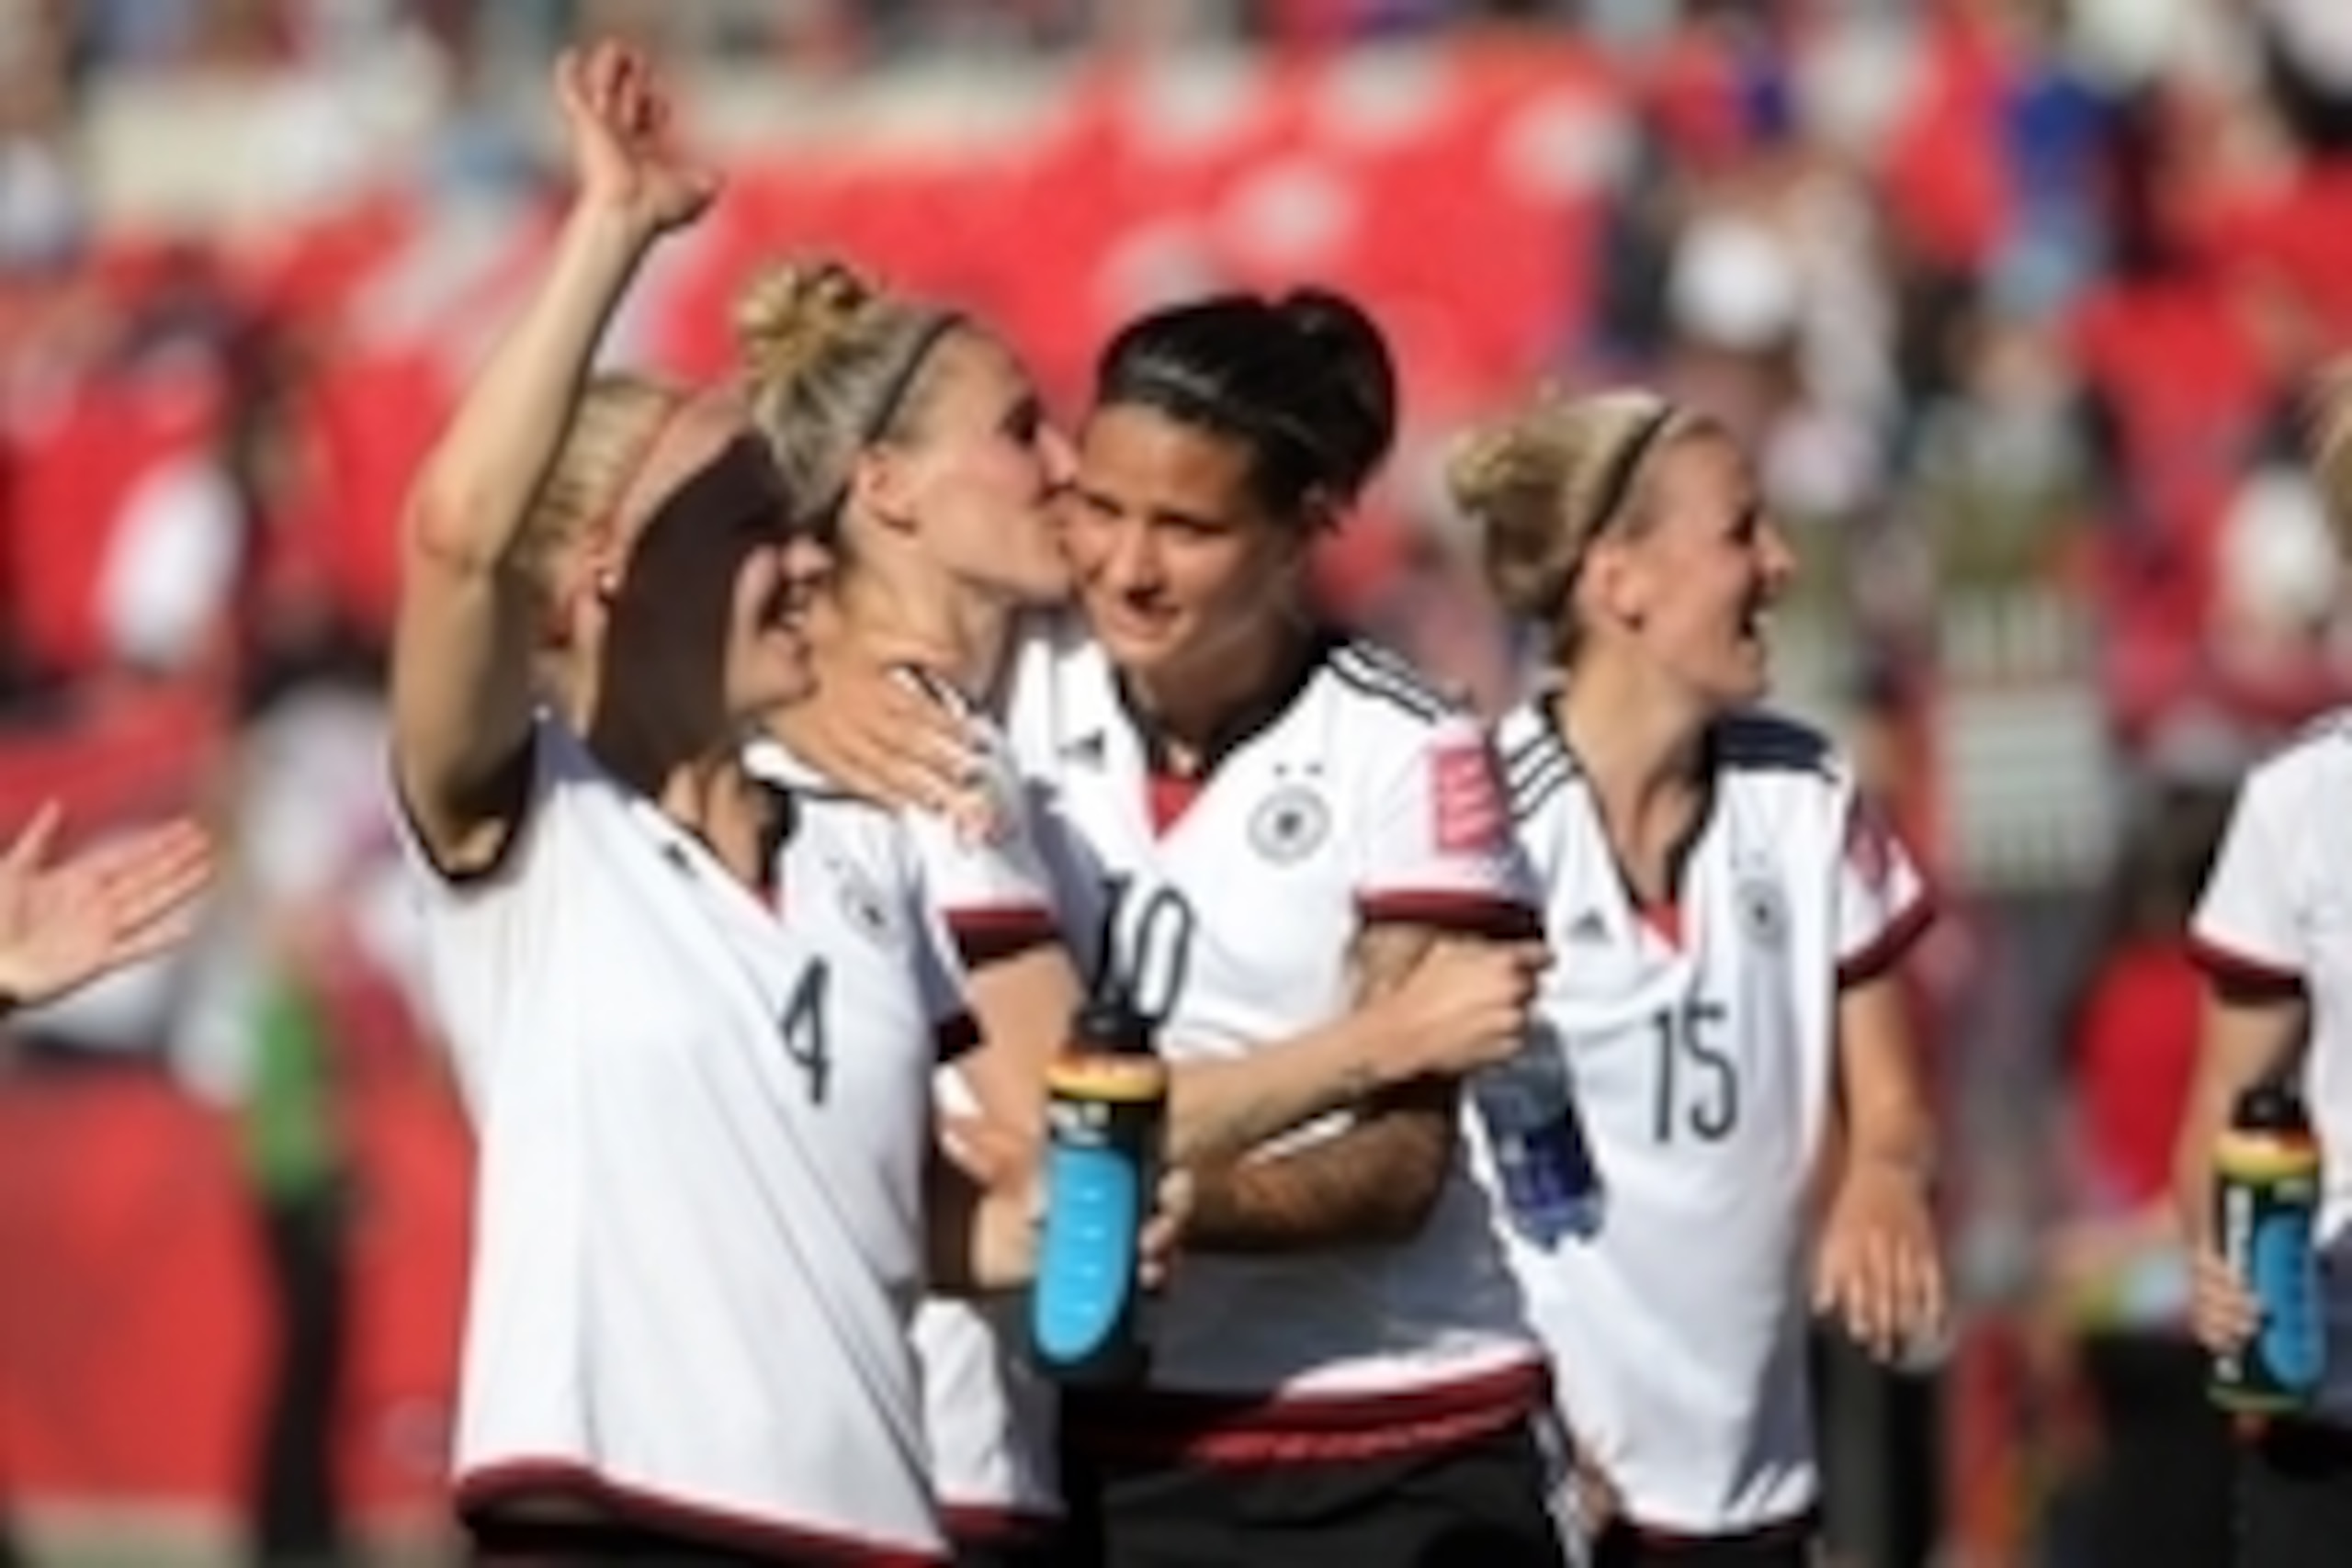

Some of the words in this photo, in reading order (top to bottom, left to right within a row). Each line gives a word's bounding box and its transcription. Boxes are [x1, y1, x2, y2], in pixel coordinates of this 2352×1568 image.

[1096, 873, 1196, 1023] 10
[781, 956, 831, 1103] 4
[1652, 1002, 1738, 1144] 15
